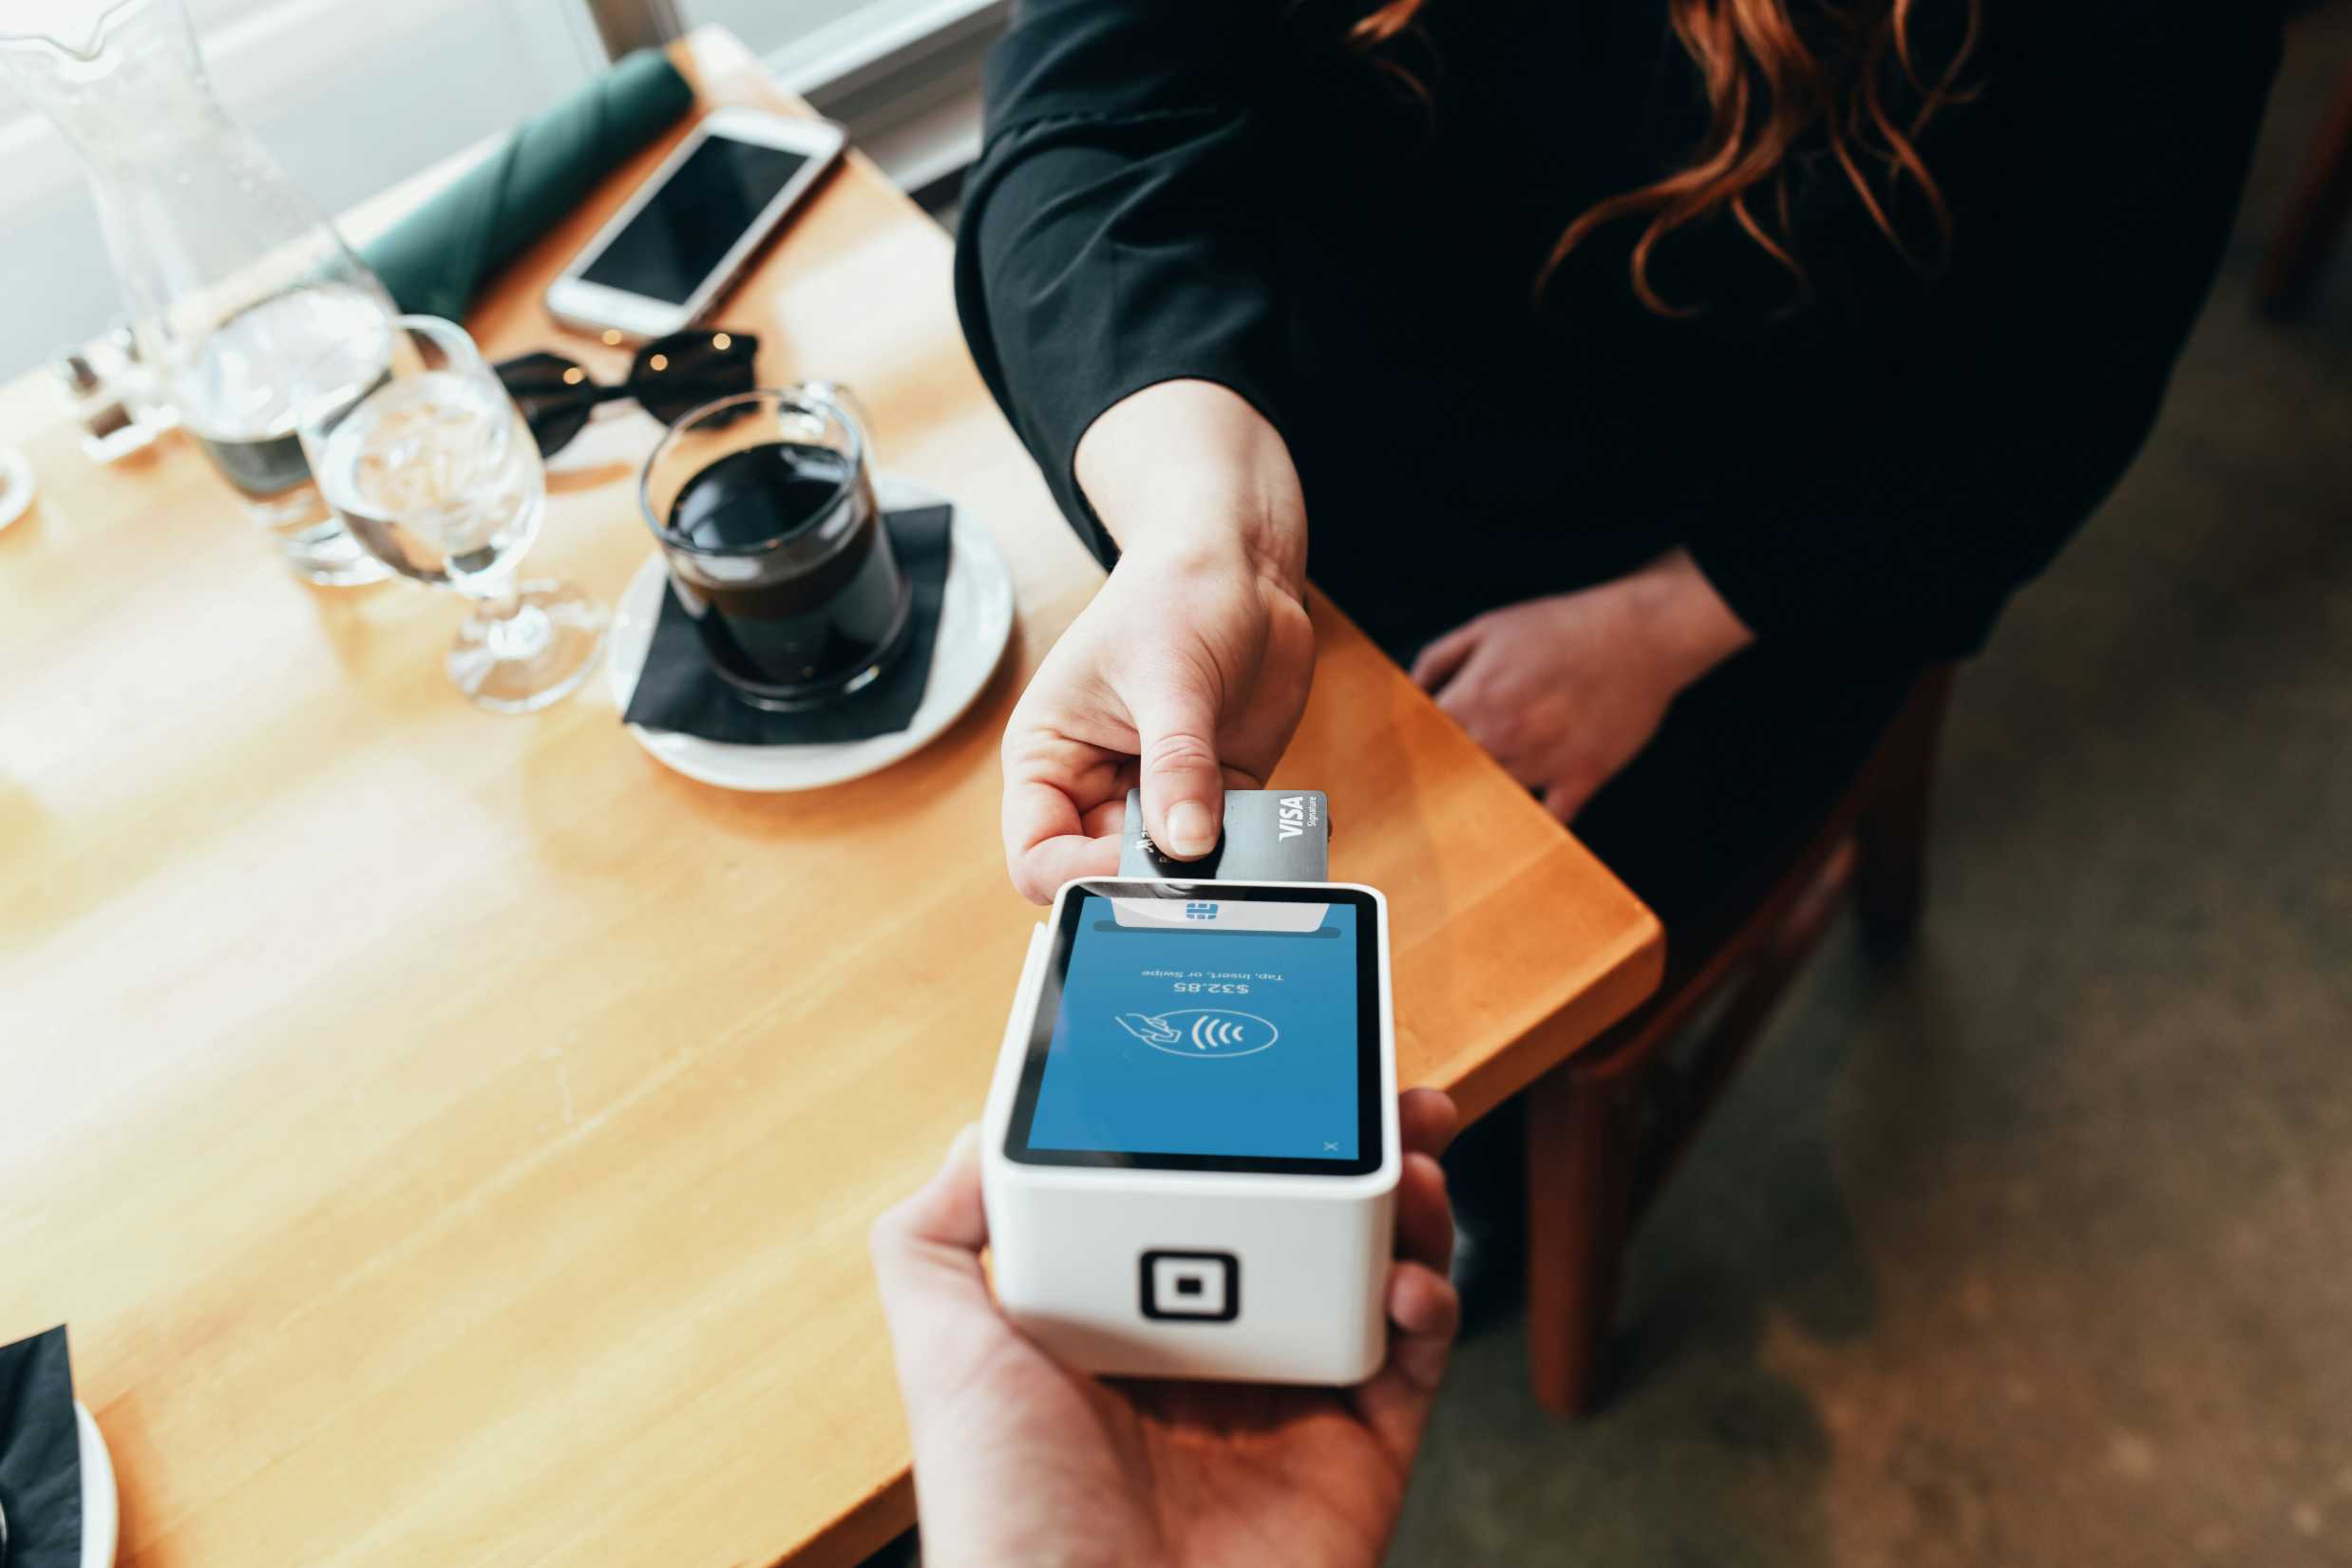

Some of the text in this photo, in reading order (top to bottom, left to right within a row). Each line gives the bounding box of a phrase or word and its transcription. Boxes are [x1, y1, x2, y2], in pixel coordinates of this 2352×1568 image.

[1307, 796, 1318, 827] Signature
[1279, 796, 1303, 842] VISA
[1142, 970, 1184, 979] Swipe
[1207, 971, 1250, 980] Insert,
[1255, 972, 1283, 981] Tap,
[1173, 982, 1249, 994] $32.85
